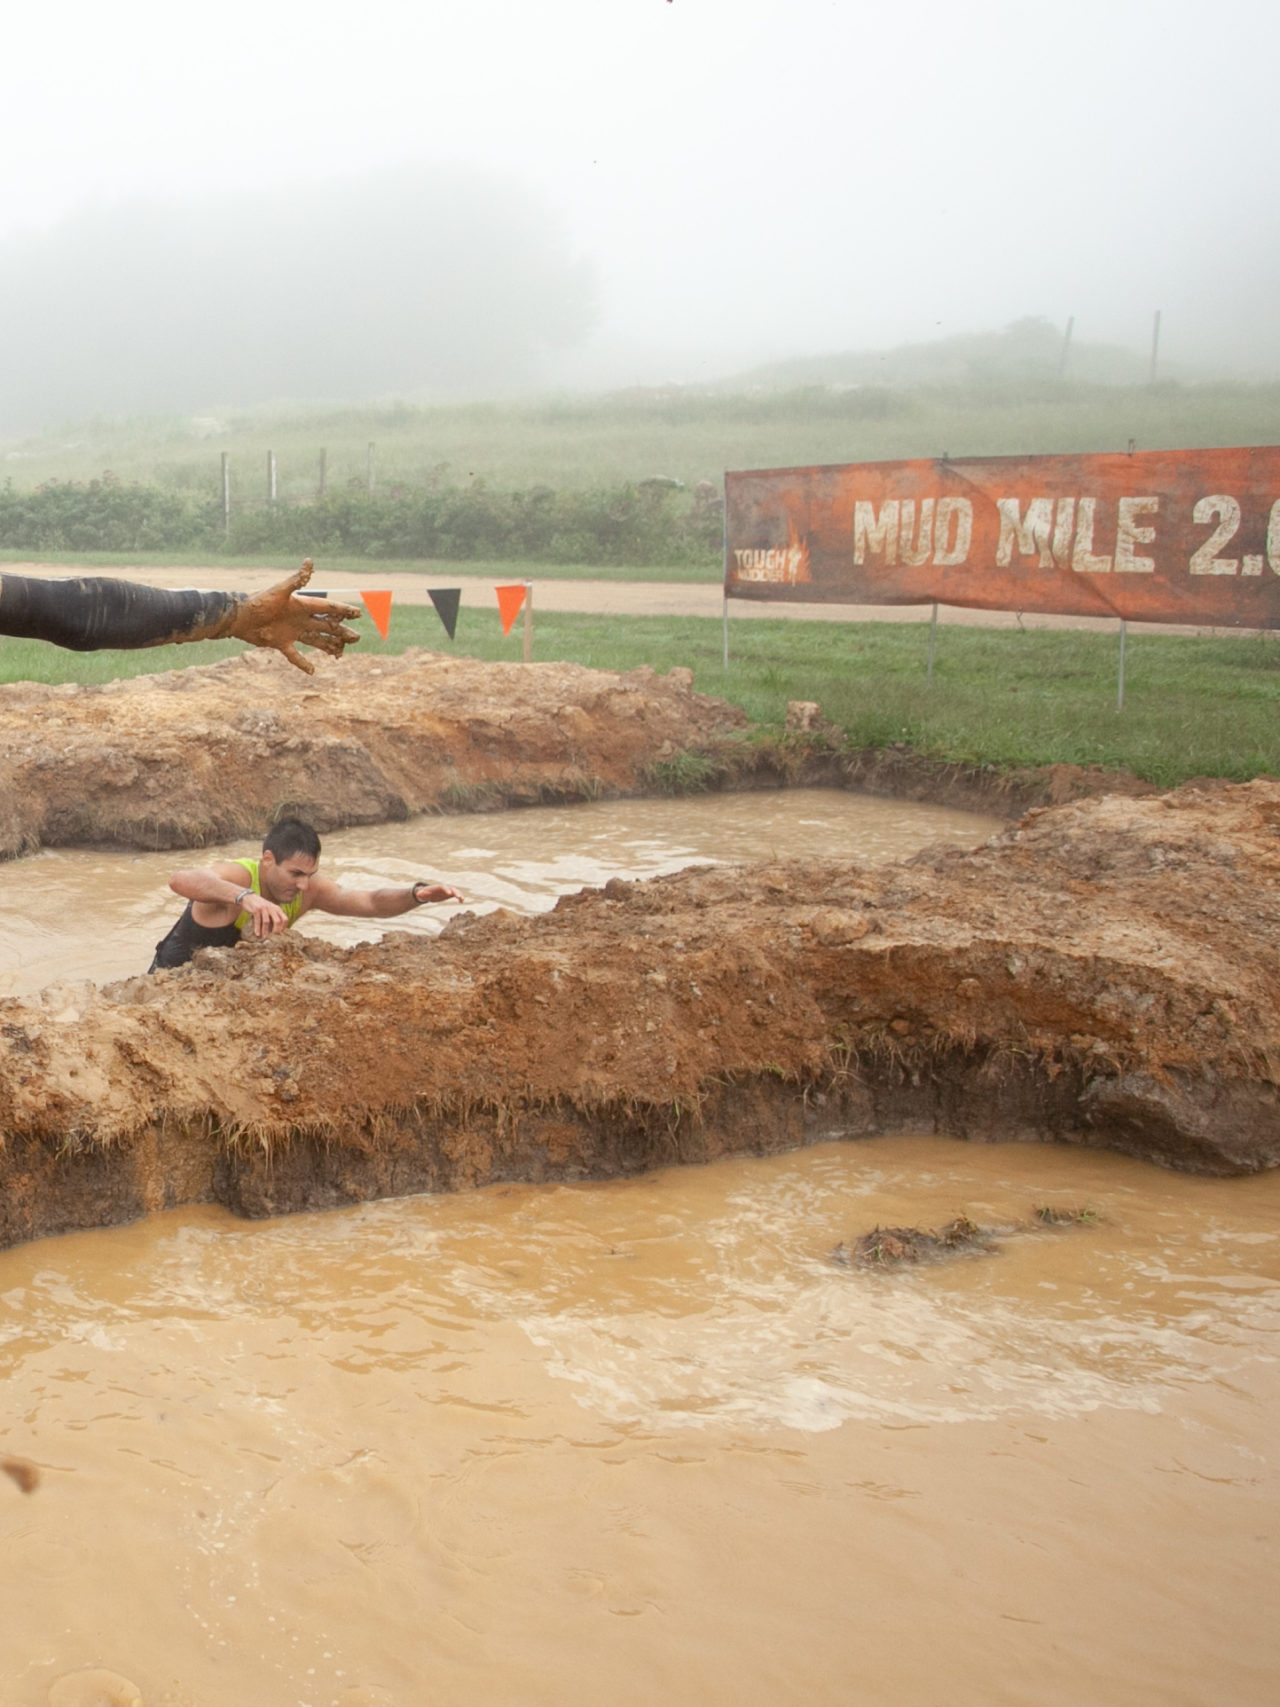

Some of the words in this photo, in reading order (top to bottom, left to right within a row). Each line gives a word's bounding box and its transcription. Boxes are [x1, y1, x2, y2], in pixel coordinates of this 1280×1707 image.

[734, 549, 787, 570] TOUGH
[853, 497, 974, 566] MUD
[995, 497, 1159, 573] MILE
[1189, 494, 1280, 576] 2.
